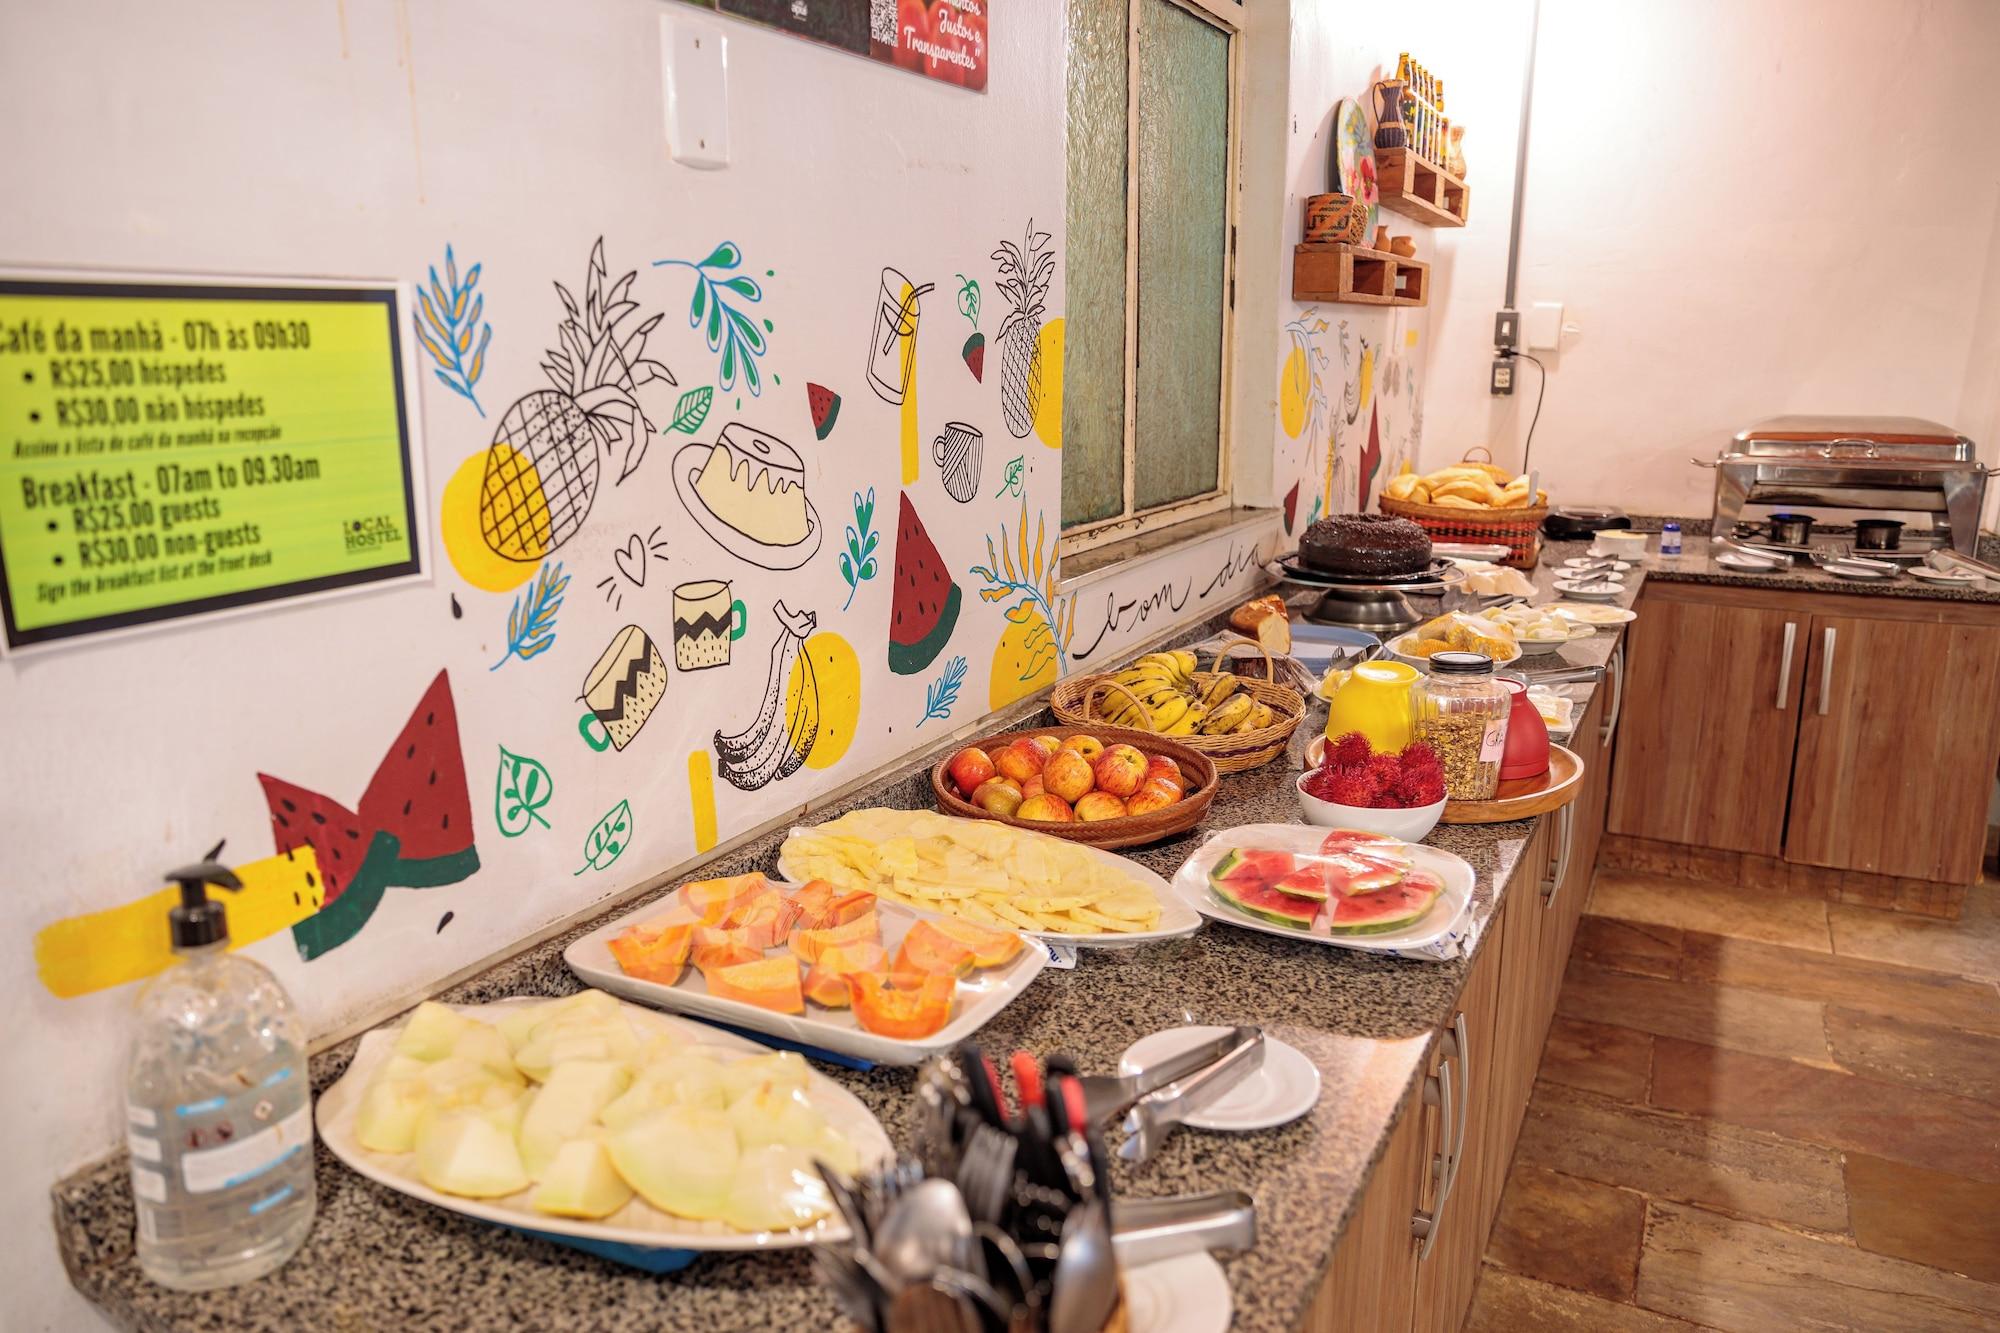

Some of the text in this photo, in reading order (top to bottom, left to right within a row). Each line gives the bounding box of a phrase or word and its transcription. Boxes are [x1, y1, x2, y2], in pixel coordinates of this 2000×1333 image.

[939, 9, 981, 43] Justos e
[54, 318, 82, 353] da
[90, 318, 164, 353] manhã
[183, 319, 220, 351] 07h
[253, 319, 310, 350] 09h30
[50, 359, 135, 388] R$25,00
[57, 397, 140, 427] R$30,00
[146, 398, 178, 421] não
[21, 469, 137, 510] Breakfast
[157, 464, 213, 494] 07am
[217, 461, 237, 489] to
[242, 454, 320, 486] 09.30am
[73, 496, 221, 536] R$25,00 guests
[343, 515, 394, 536] LOCAL
[78, 523, 261, 569] R$30,00 non-guests
[344, 529, 402, 549] HOSTEL
[97, 568, 156, 593] breakfast
[197, 560, 214, 577] the
[248, 549, 272, 568] desk
[1072, 540, 1266, 660] bom dia
